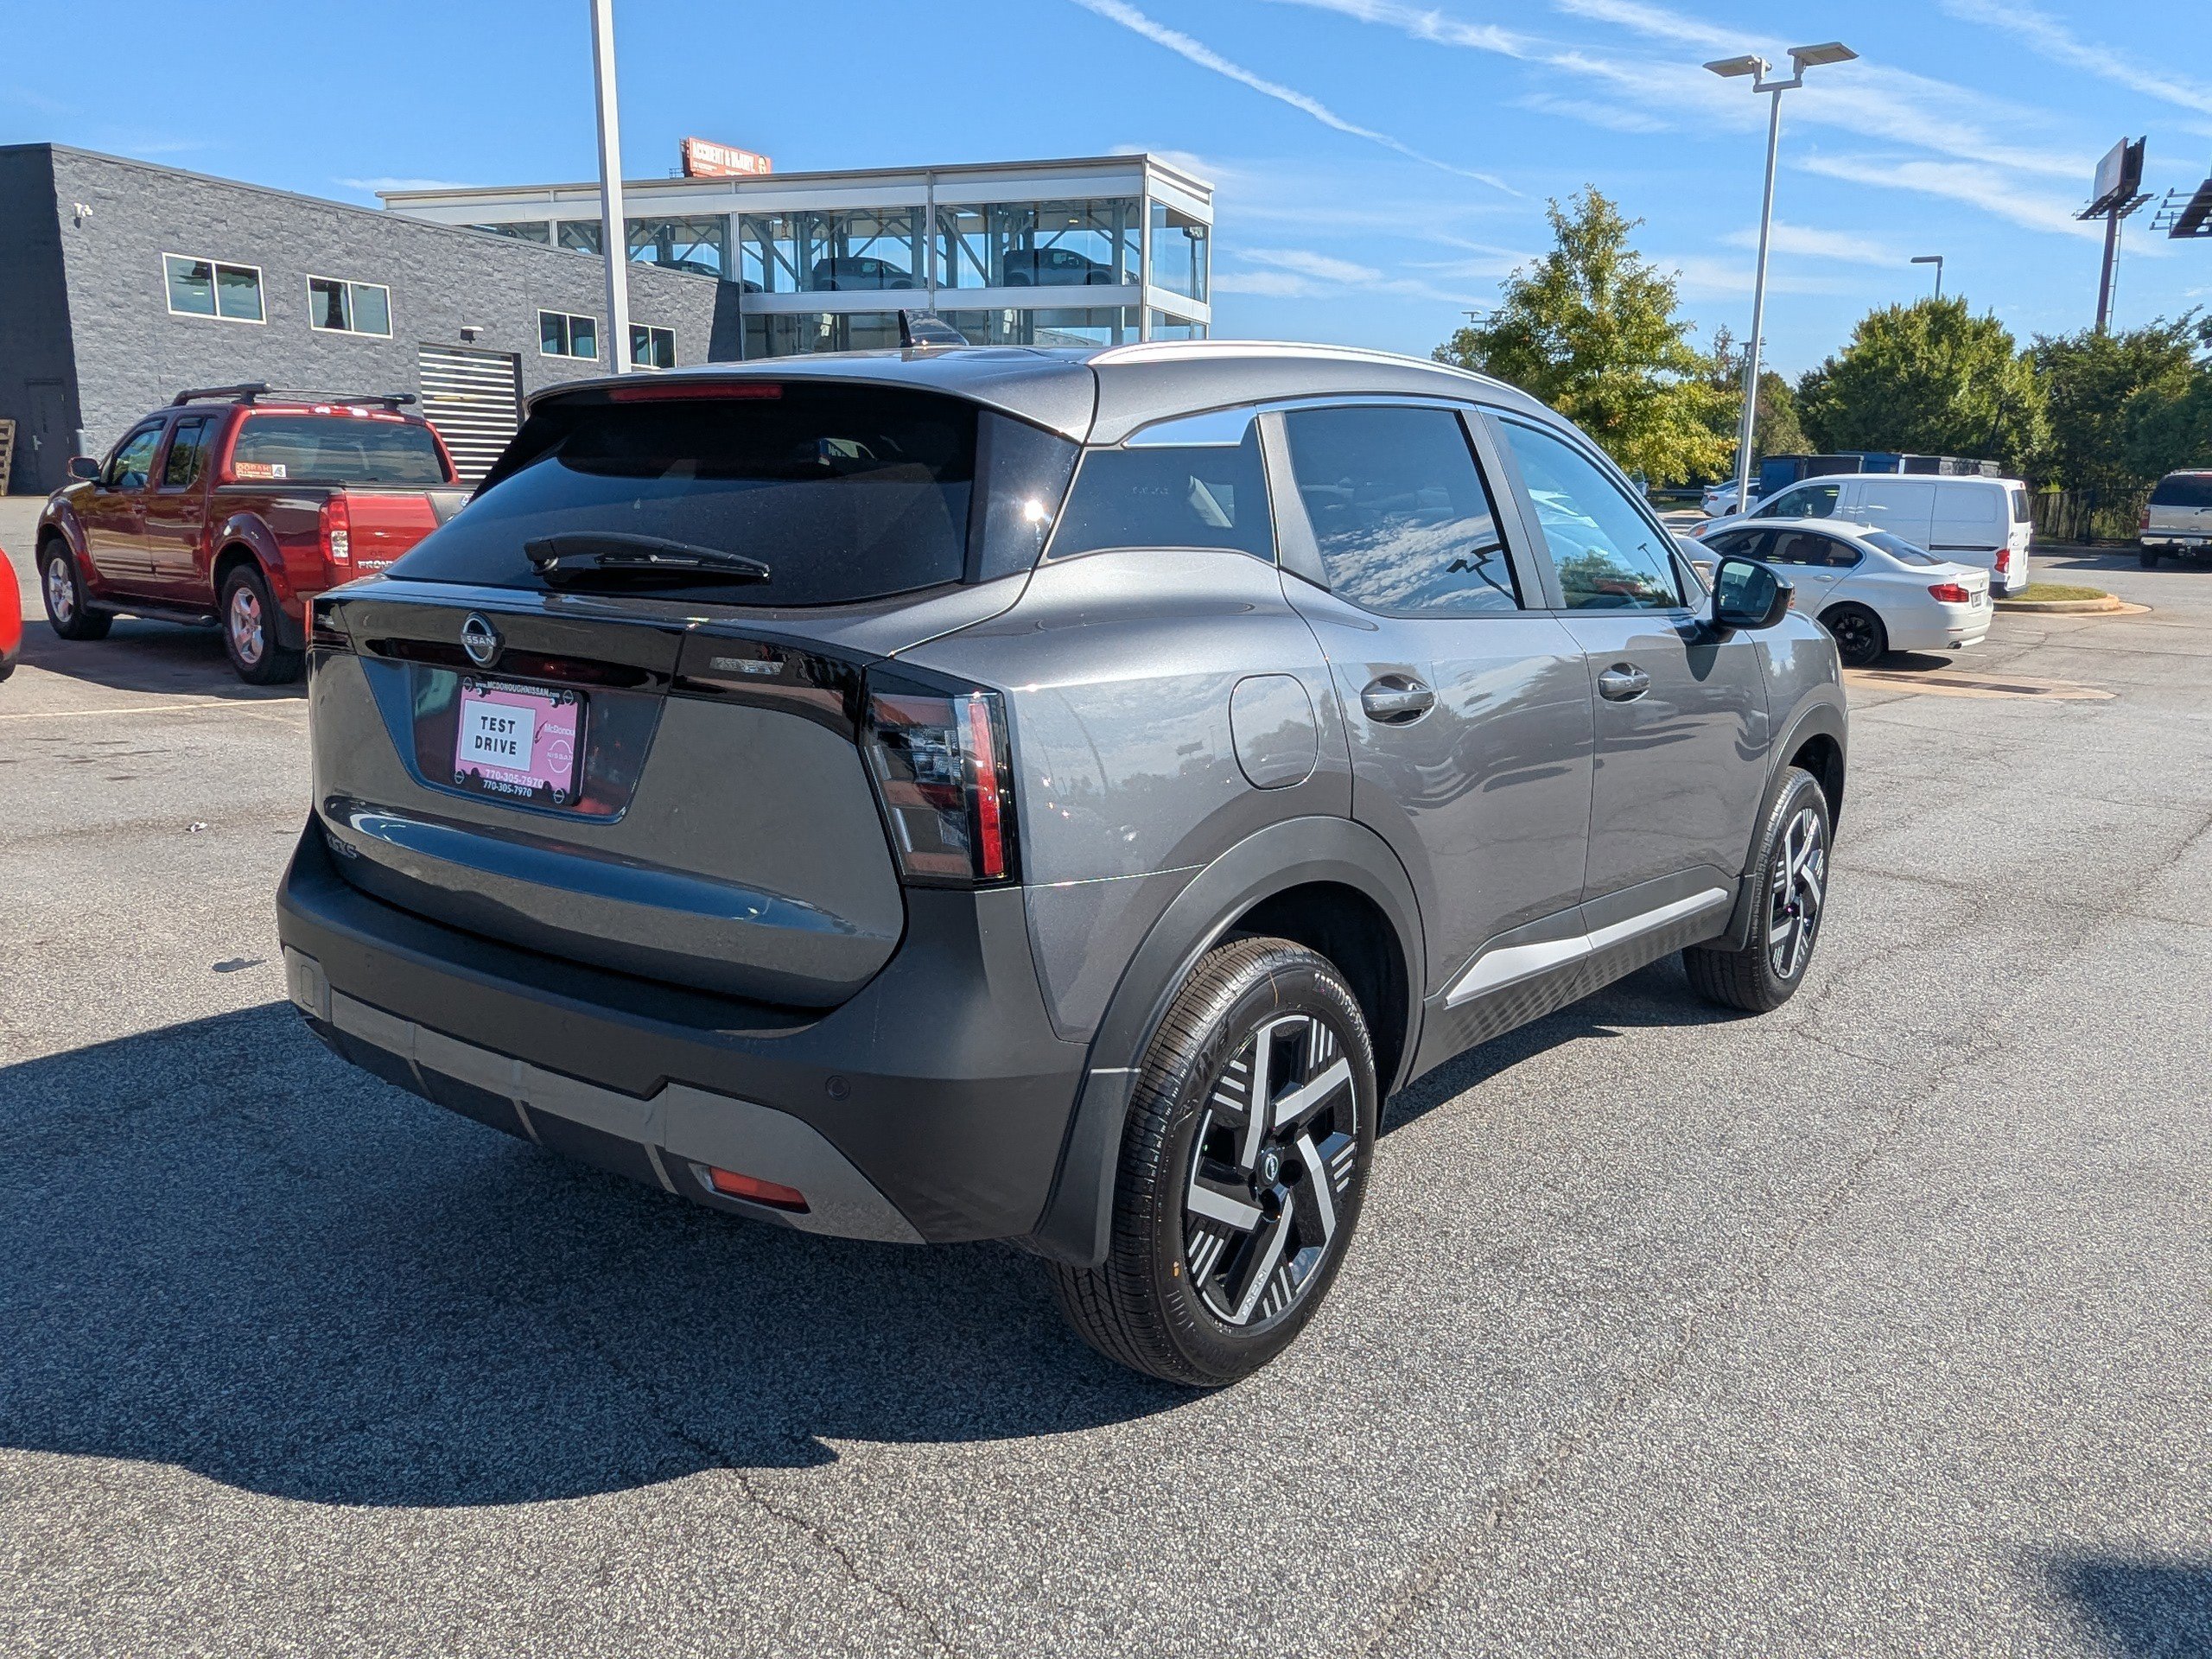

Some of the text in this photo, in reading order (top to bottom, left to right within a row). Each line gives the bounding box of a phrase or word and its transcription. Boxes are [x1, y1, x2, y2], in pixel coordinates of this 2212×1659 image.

[480, 715, 516, 734] TEST
[474, 734, 517, 755] DRIVE
[483, 779, 532, 798] 770-305-7970
[485, 769, 543, 789] 770-305-7970
